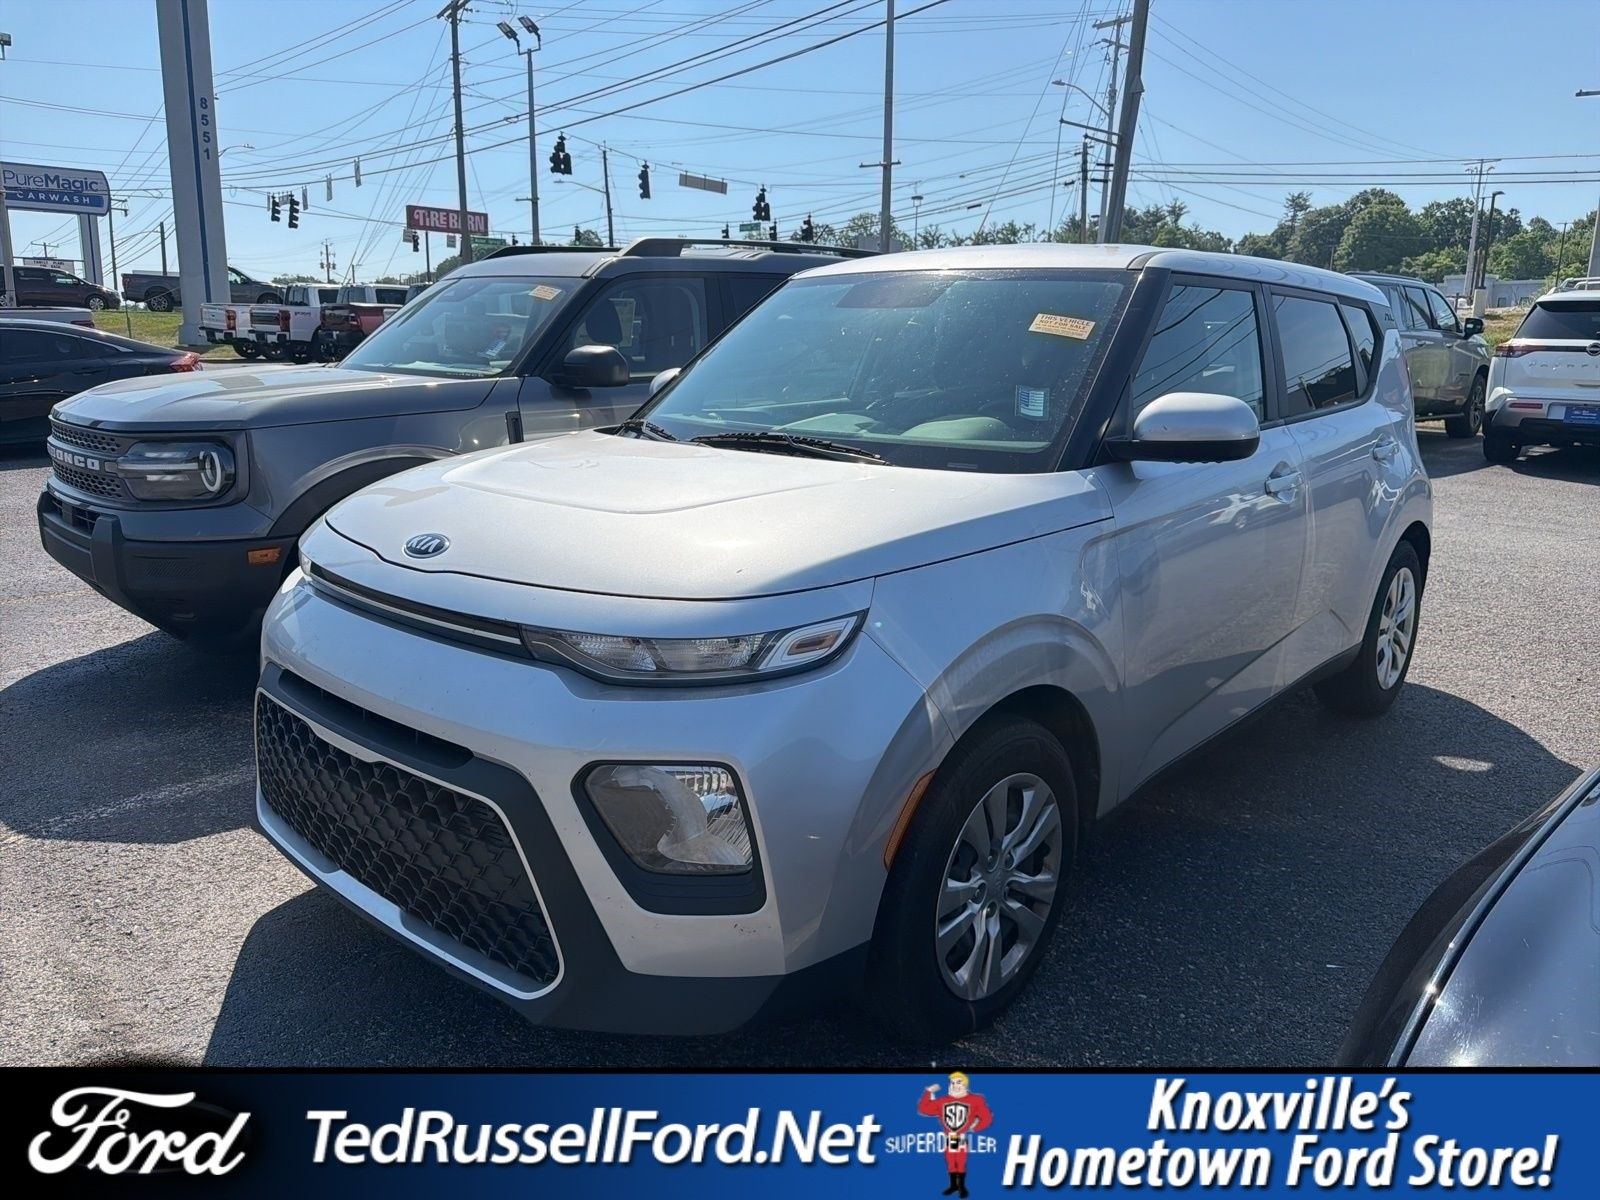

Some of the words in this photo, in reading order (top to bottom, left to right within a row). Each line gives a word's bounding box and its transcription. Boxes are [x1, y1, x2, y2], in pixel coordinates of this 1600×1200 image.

[200, 97, 211, 160] 8551
[2, 169, 99, 193] PureMagic
[16, 191, 90, 204] CARWASH
[448, 213, 485, 233] BRN
[1060, 318, 1091, 326] VEHICLE
